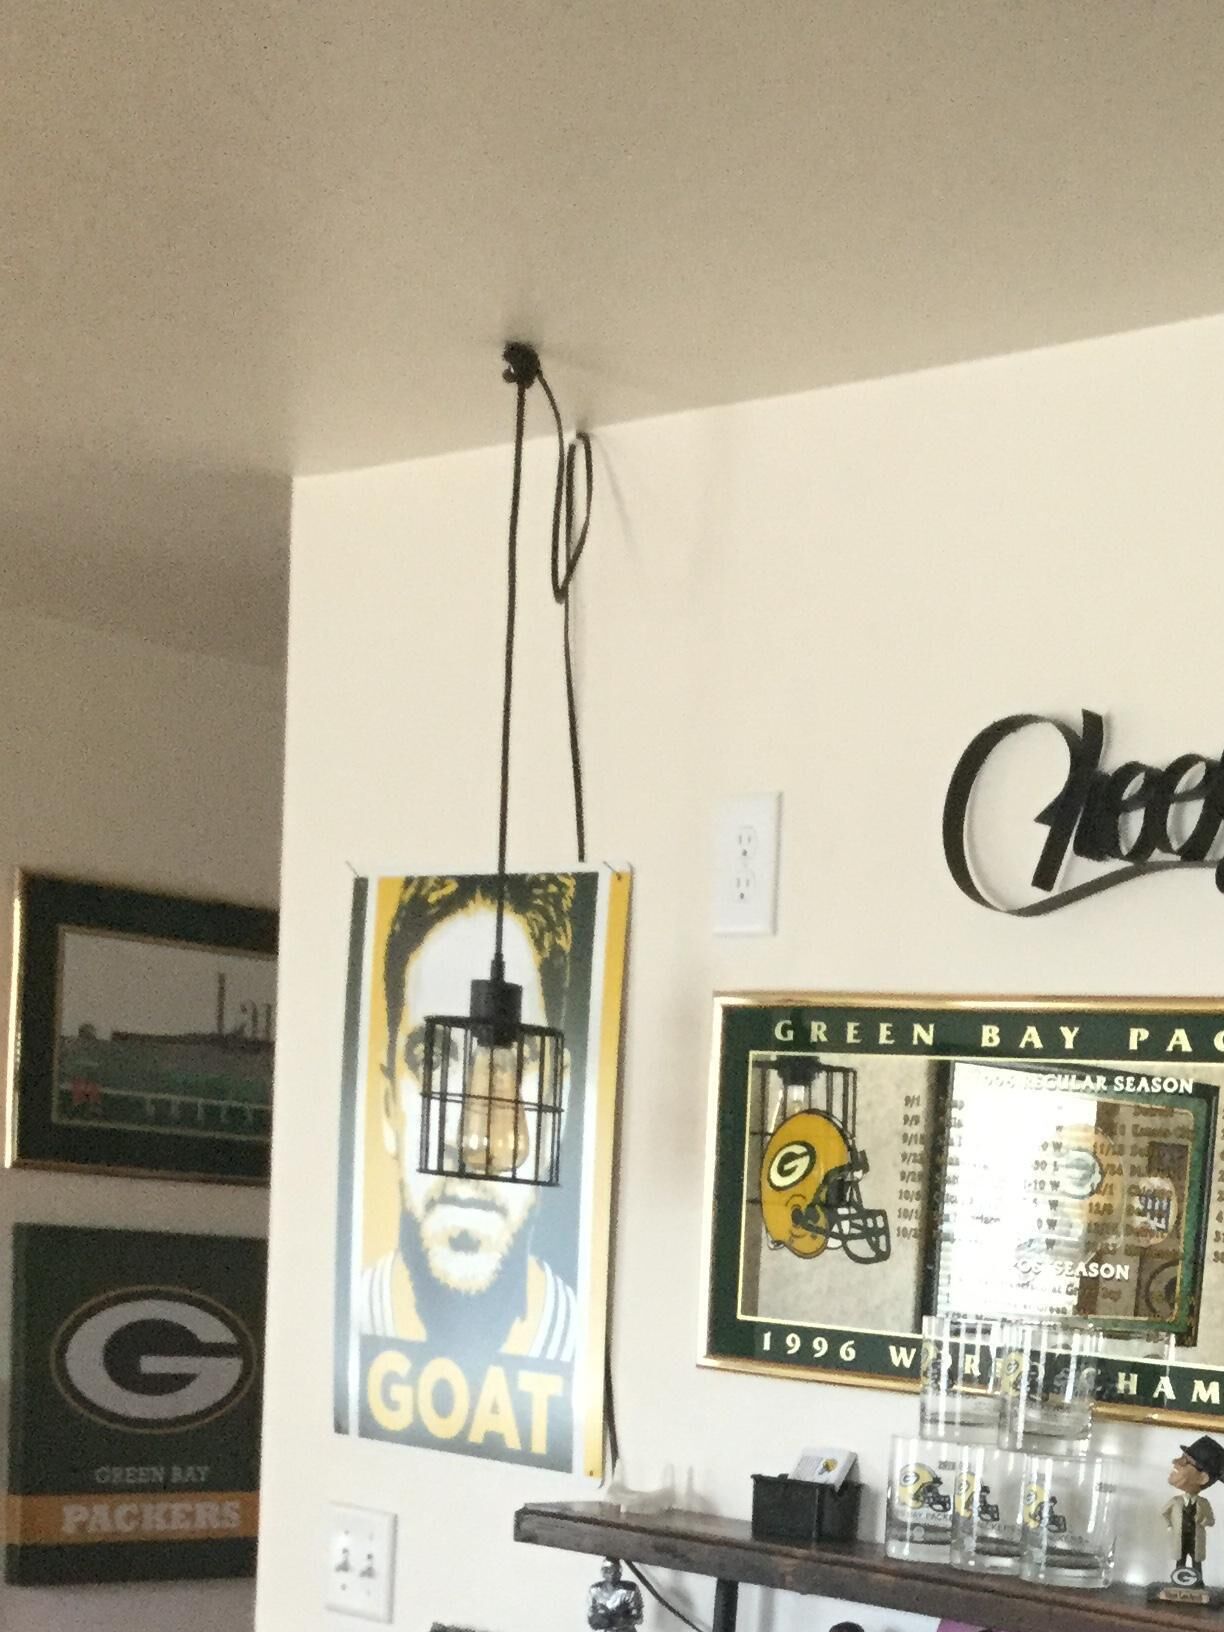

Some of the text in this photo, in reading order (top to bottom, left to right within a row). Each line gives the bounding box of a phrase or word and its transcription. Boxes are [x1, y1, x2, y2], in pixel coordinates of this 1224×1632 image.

[774, 1020, 936, 1046] GREEN
[980, 1024, 1081, 1050] BAY
[1113, 1075, 1195, 1095] SEASON
[761, 1331, 857, 1362] 1996
[366, 1349, 565, 1456] GOAT
[94, 1465, 210, 1484] GREEN BAY
[61, 1500, 241, 1535] PACKERS
